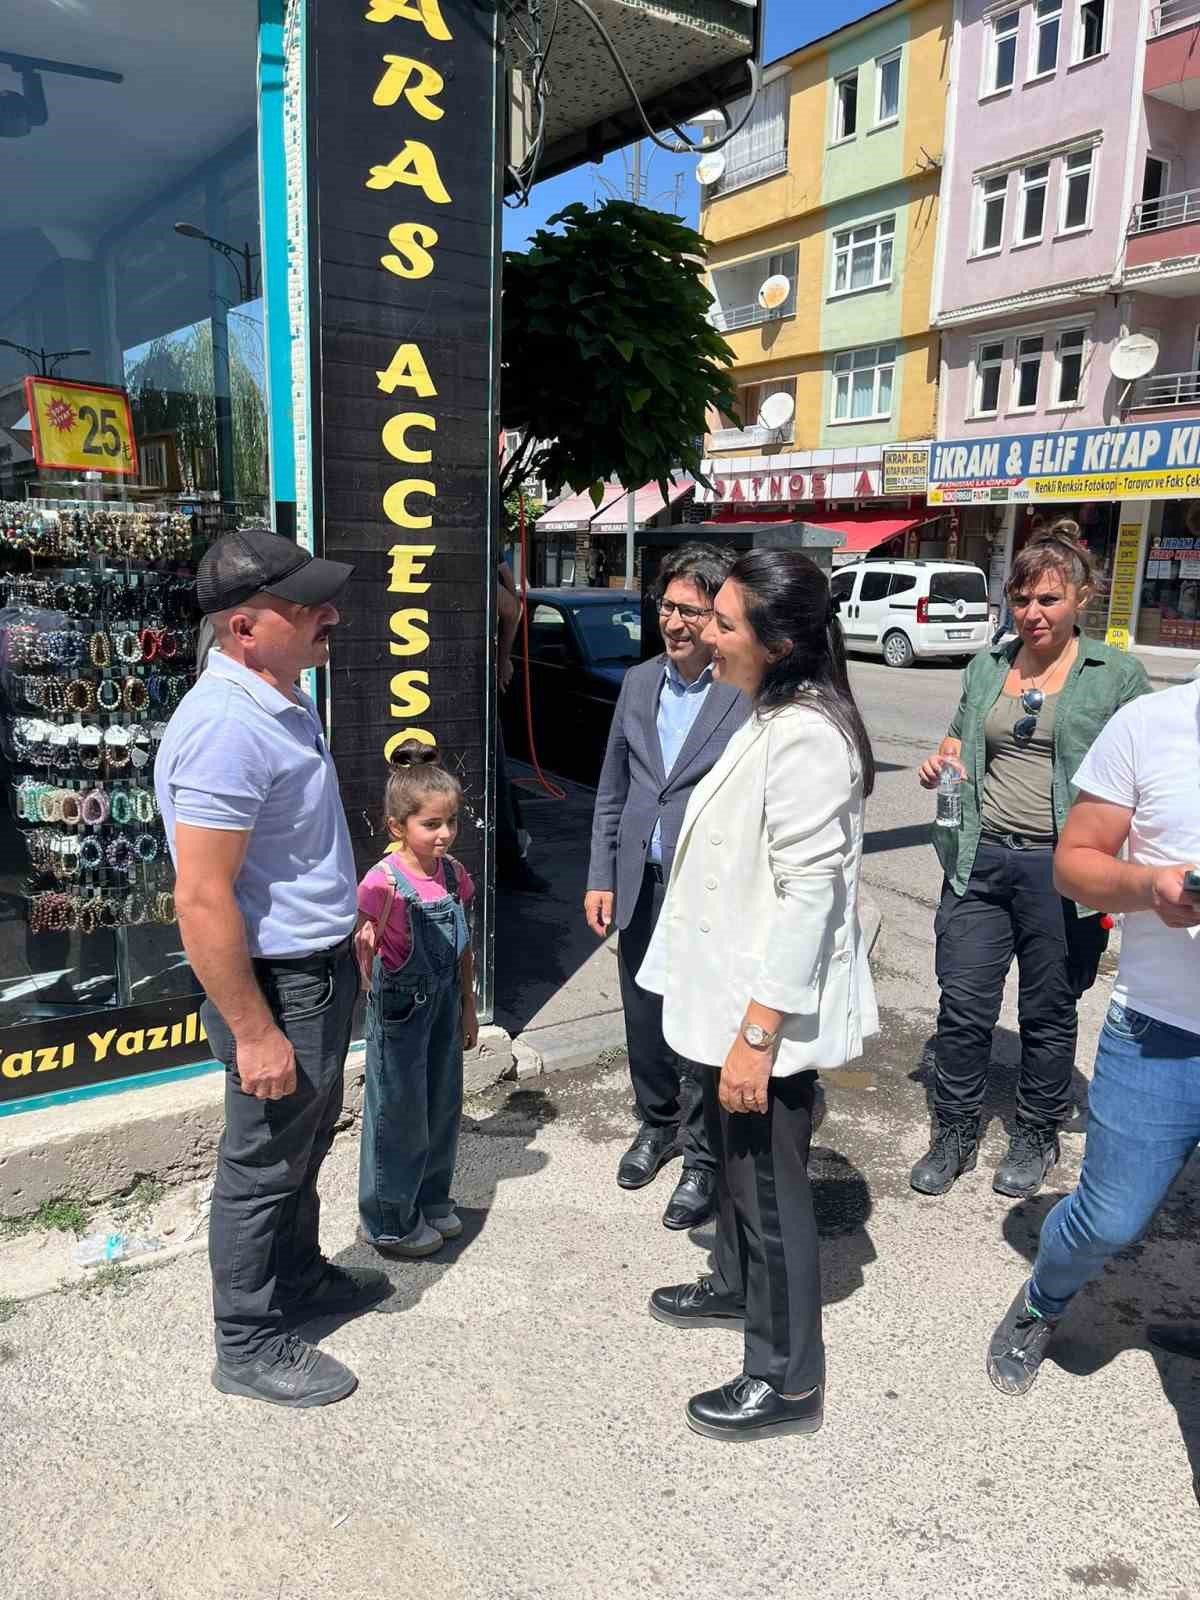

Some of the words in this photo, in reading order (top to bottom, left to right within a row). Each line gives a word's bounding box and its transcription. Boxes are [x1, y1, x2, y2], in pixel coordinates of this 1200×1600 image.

[1005, 441, 1023, 476] &
[1166, 425, 1200, 466] KI
[1, 1042, 76, 1079] azı
